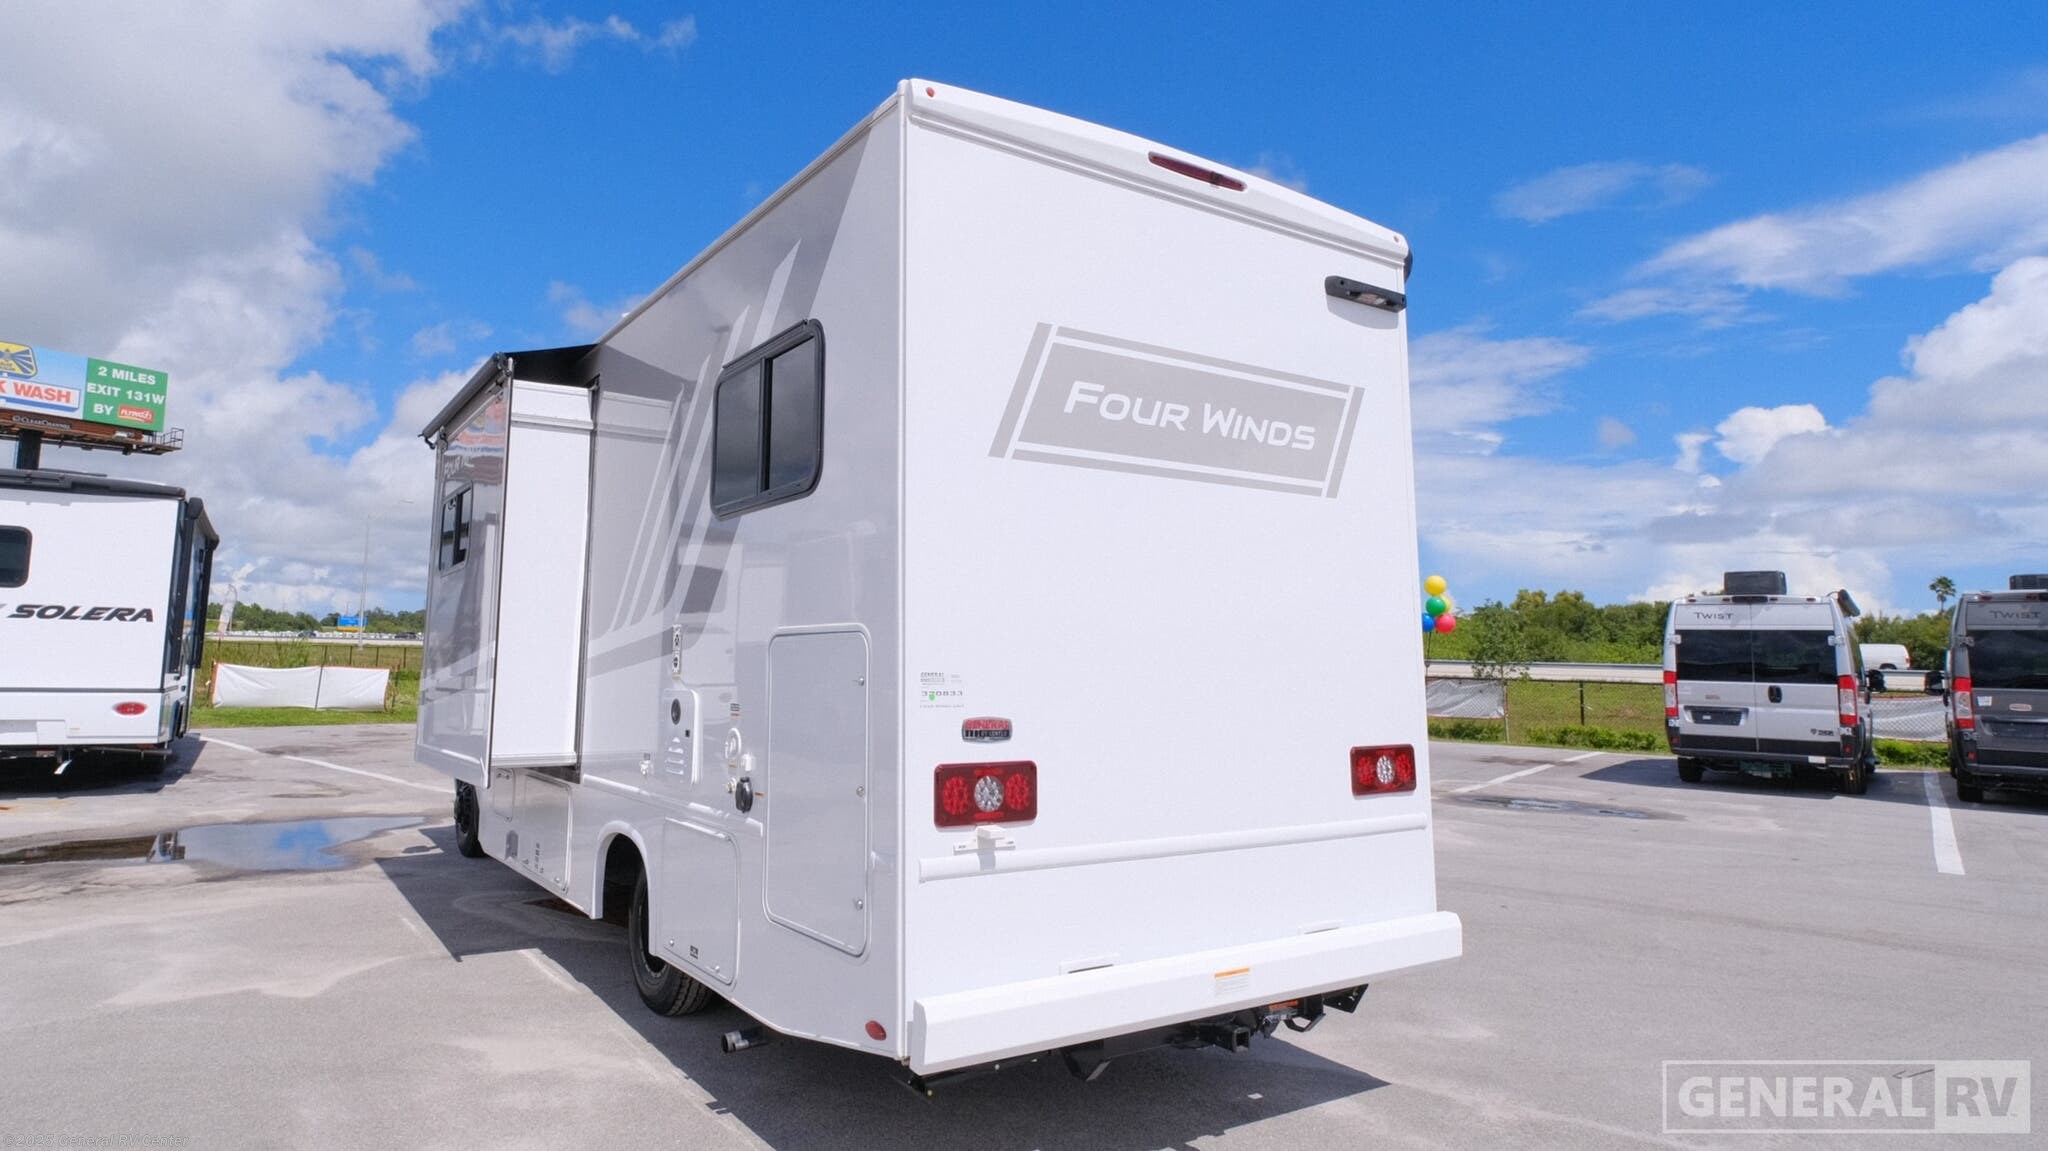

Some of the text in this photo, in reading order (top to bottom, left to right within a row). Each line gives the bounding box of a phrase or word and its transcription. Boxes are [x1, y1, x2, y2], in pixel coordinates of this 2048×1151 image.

[98, 366, 156, 385] 2 MILES
[13, 381, 72, 404] WASH
[87, 382, 165, 405] EXIT 131W
[93, 403, 114, 416] BY
[1064, 380, 1315, 451] FOUR WINDS
[6, 603, 155, 623] SOLERA
[1693, 611, 1735, 620] TWIST
[1989, 610, 2041, 619] TWIST
